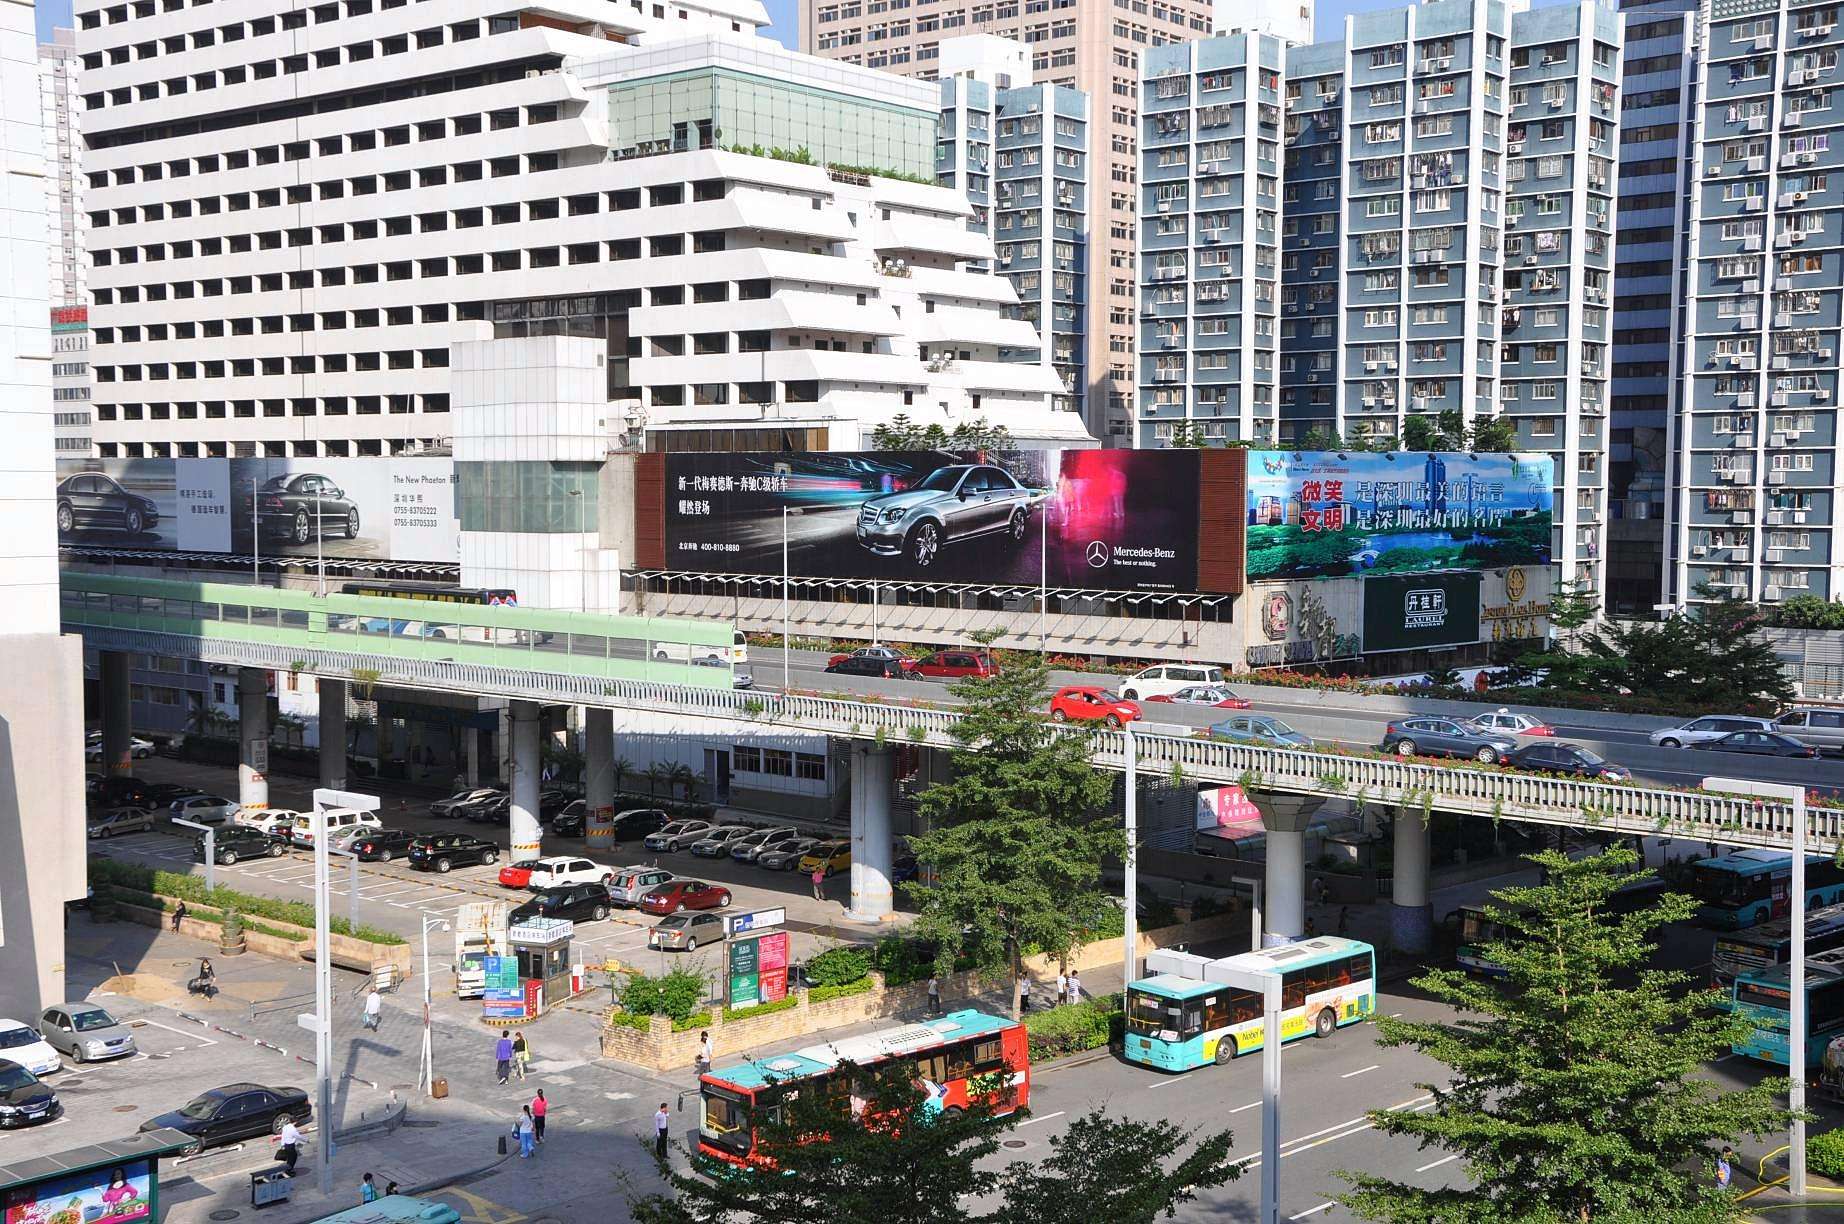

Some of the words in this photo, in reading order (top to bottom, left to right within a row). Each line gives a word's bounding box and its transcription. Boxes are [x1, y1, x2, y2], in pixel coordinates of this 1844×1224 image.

[393, 475, 404, 484] The
[405, 475, 419, 484] New
[421, 475, 446, 484] Phaeton
[1301, 480, 1344, 502] 微笑
[1301, 508, 1344, 532] 文明
[1355, 509, 1503, 531] 是深圳最好的名片
[1113, 546, 1175, 558] Mercedes-Benz
[733, 918, 744, 932] P
[488, 957, 498, 970] P
